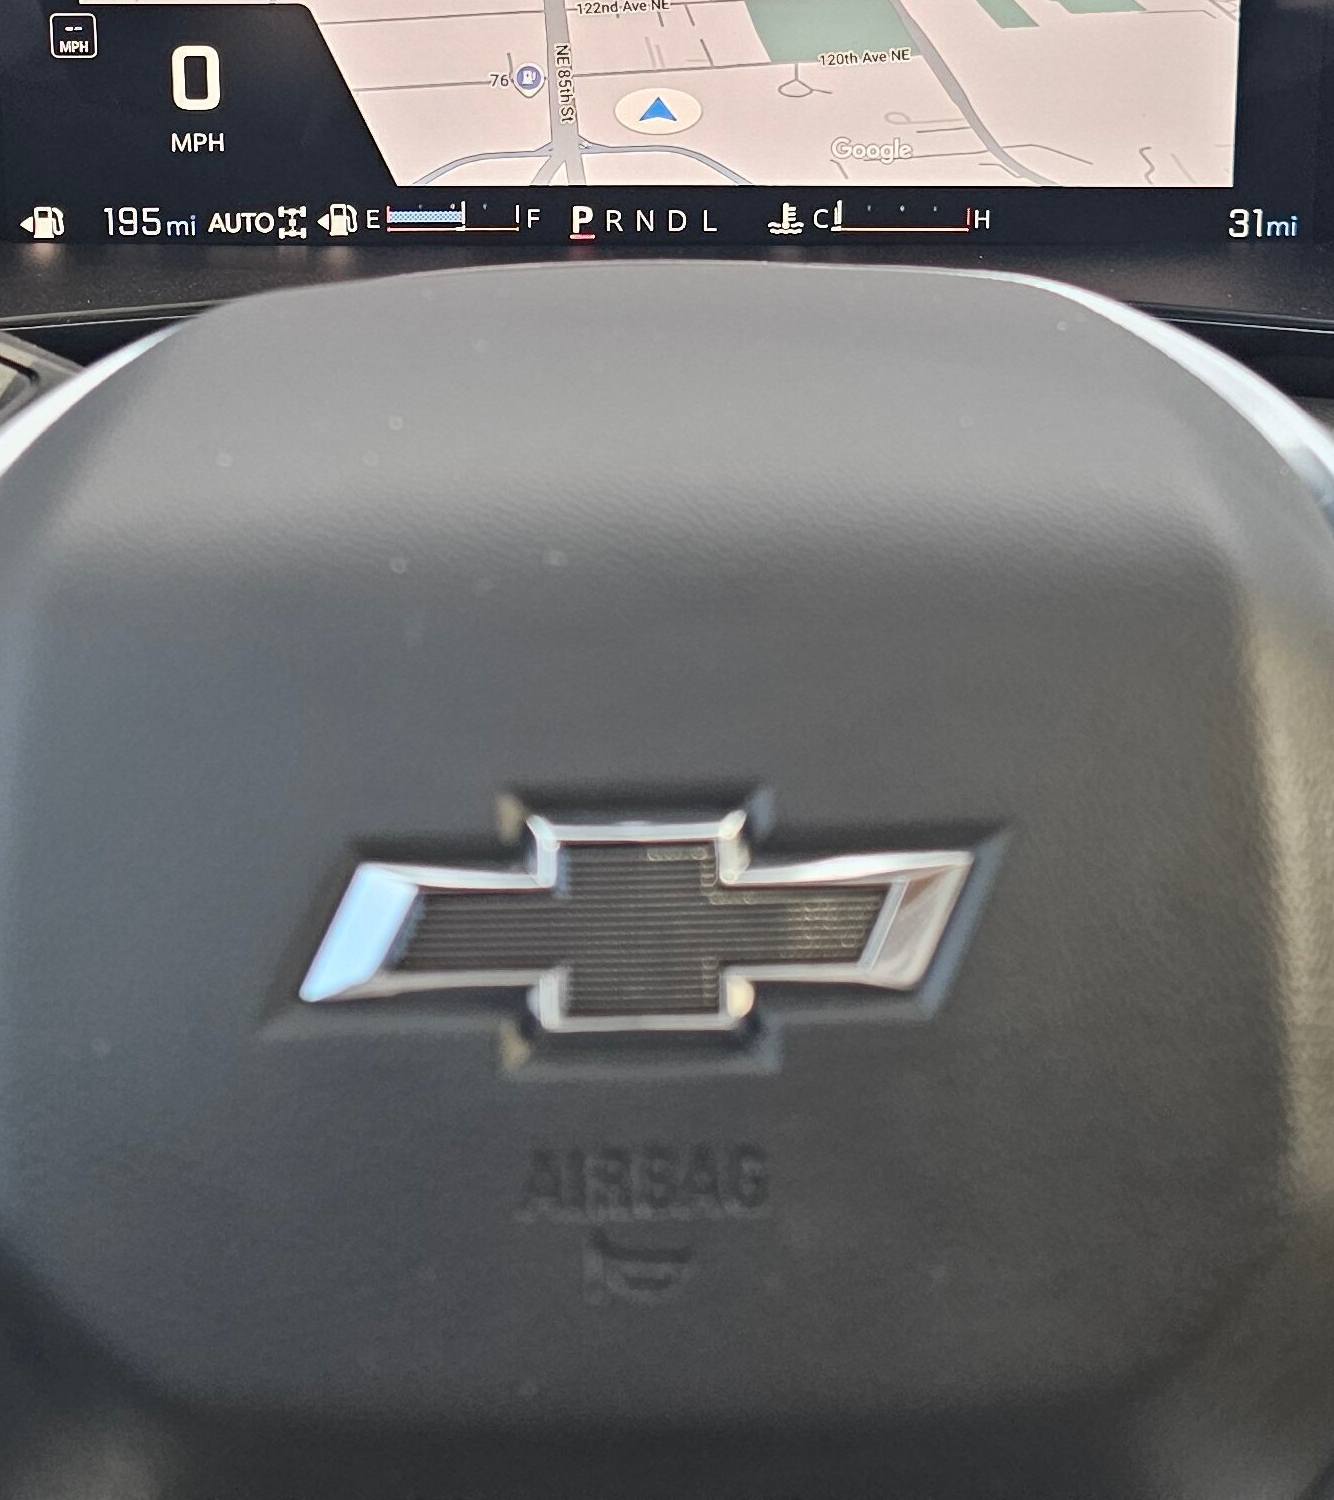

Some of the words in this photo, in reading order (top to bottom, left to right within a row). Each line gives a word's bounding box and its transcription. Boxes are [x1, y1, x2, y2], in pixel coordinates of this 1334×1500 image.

[577, 0, 618, 14] 122nd
[622, 0, 648, 12] Ave
[59, 40, 89, 53] MPH
[556, 45, 571, 65] NE
[819, 52, 858, 66] 120th
[862, 52, 887, 64] Ave
[891, 49, 910, 61] NE
[171, 45, 221, 111] 0
[489, 74, 510, 88] 76
[558, 69, 575, 103] 85th
[561, 106, 575, 123] St
[171, 132, 225, 153] MPH
[831, 136, 913, 165] Google
[207, 212, 275, 234] AUTO
[366, 209, 381, 229] E
[527, 208, 541, 229] F
[813, 208, 829, 229] C
[974, 209, 991, 230] H
[522, 1142, 771, 1212] AIRBAG
